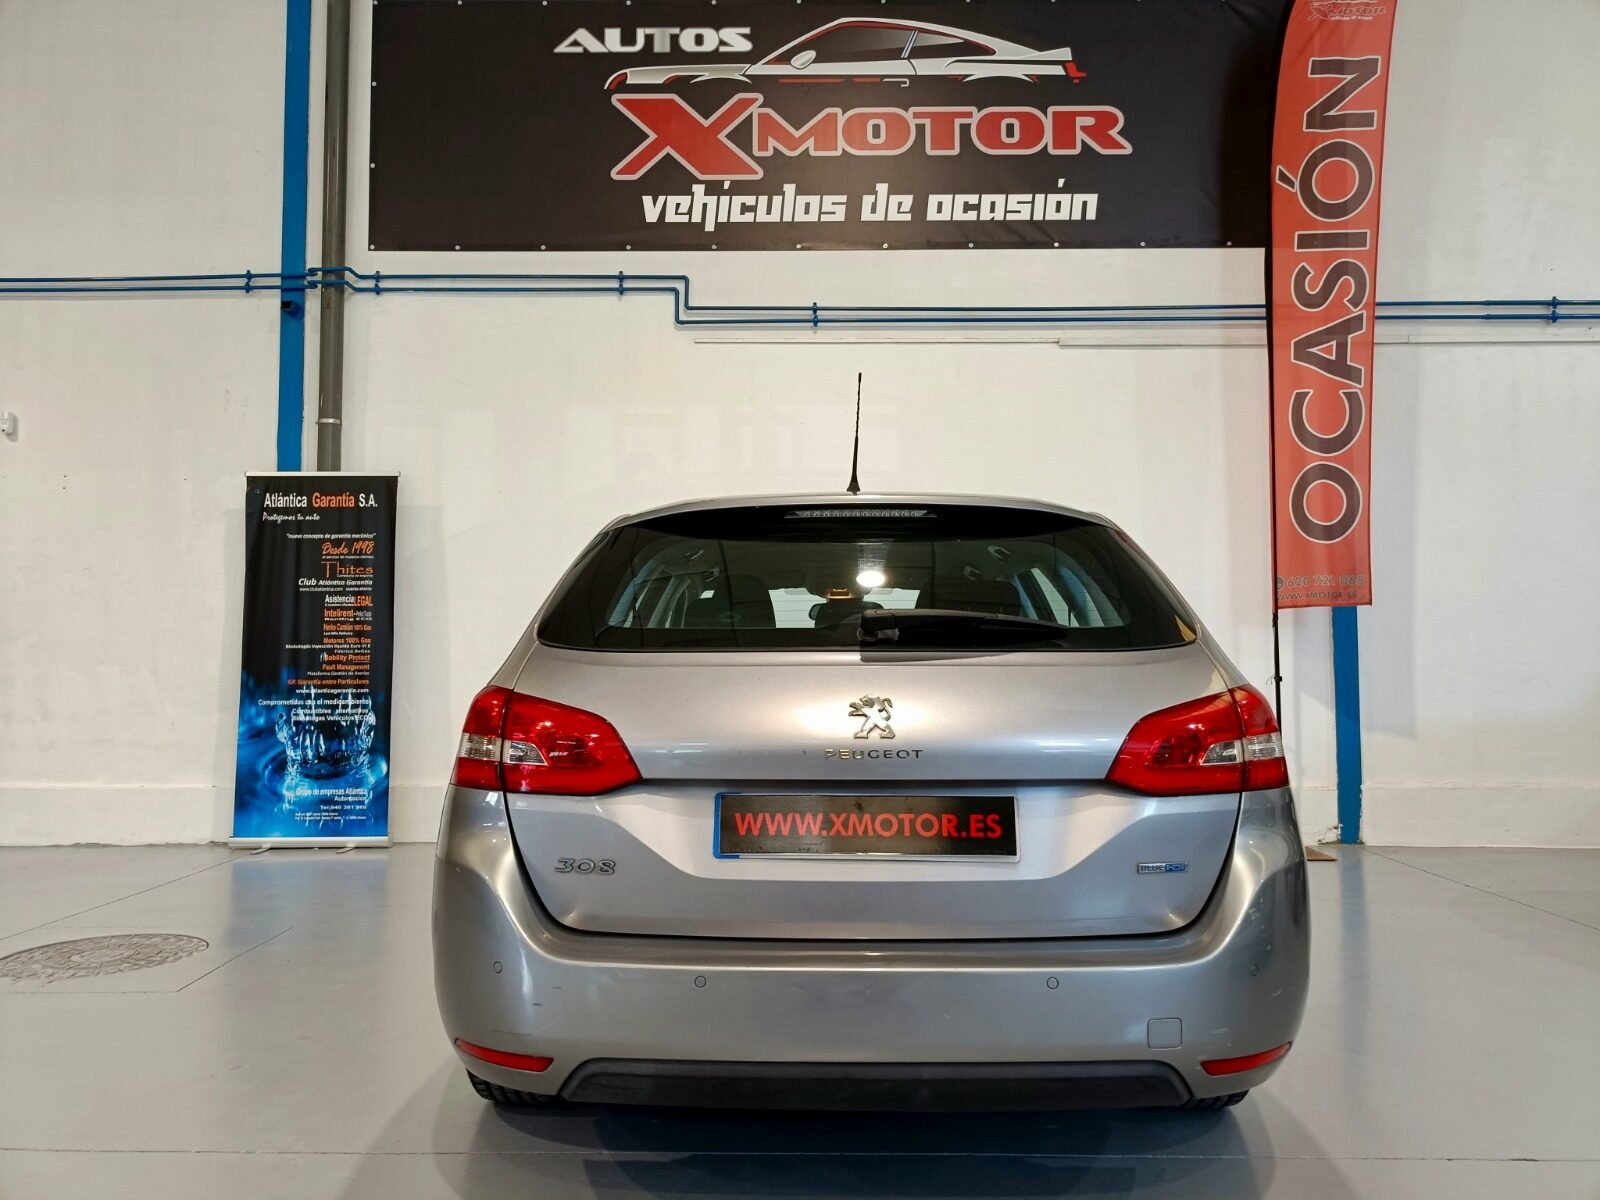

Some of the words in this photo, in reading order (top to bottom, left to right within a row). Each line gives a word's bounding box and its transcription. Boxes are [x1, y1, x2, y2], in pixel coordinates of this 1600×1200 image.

[553, 27, 753, 53] AUTOS
[611, 92, 1133, 180] XMOTOR
[642, 180, 848, 231] vehículos
[860, 183, 912, 222] de
[926, 178, 1098, 222] ocasión
[1275, 55, 1382, 544] OCASIÓN
[263, 492, 308, 508] Atlántica
[312, 492, 355, 508] Garantía
[358, 493, 378, 508] S.A.
[305, 512, 320, 521] auto
[322, 542, 348, 555] Desde
[351, 541, 375, 555] 1998
[298, 578, 317, 586] Club
[824, 749, 924, 760] PEUGEOT
[734, 813, 1003, 839] WWW.XMOTOR.ES
[554, 858, 617, 875] 308
